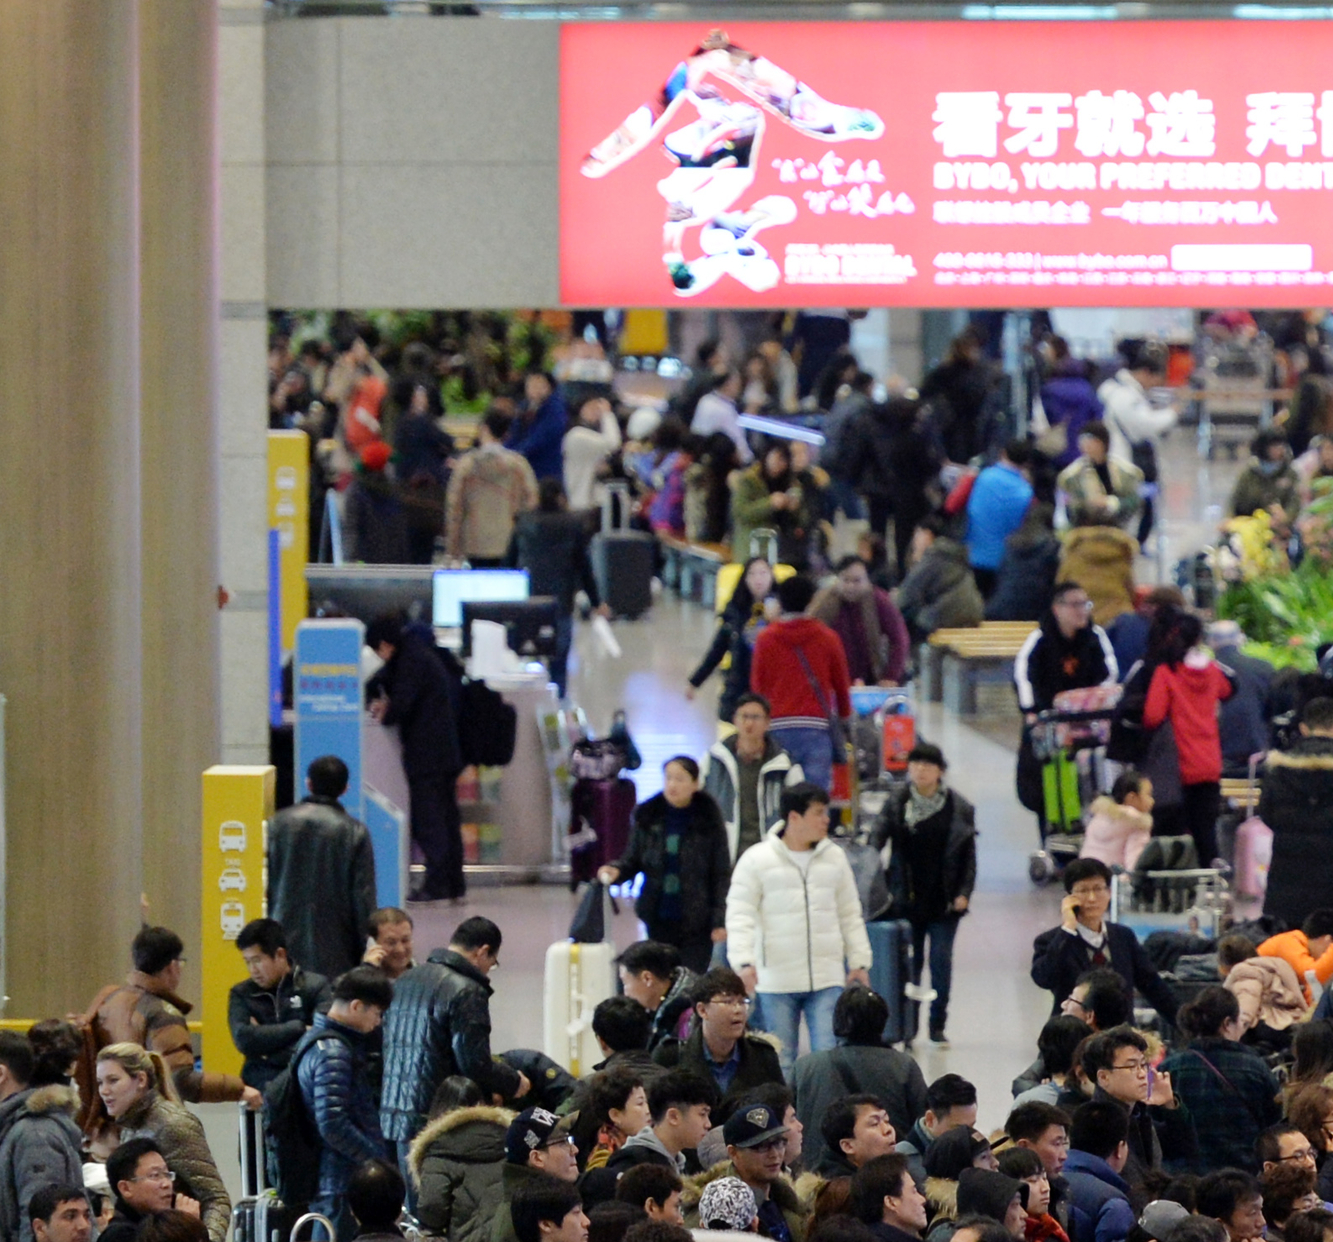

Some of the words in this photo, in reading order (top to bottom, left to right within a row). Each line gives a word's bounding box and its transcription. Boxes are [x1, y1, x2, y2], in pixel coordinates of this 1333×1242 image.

[931, 90, 1215, 158] 看牙就选
[1022, 162, 1097, 189] YOUR
[1100, 162, 1262, 189] PREFERRED
